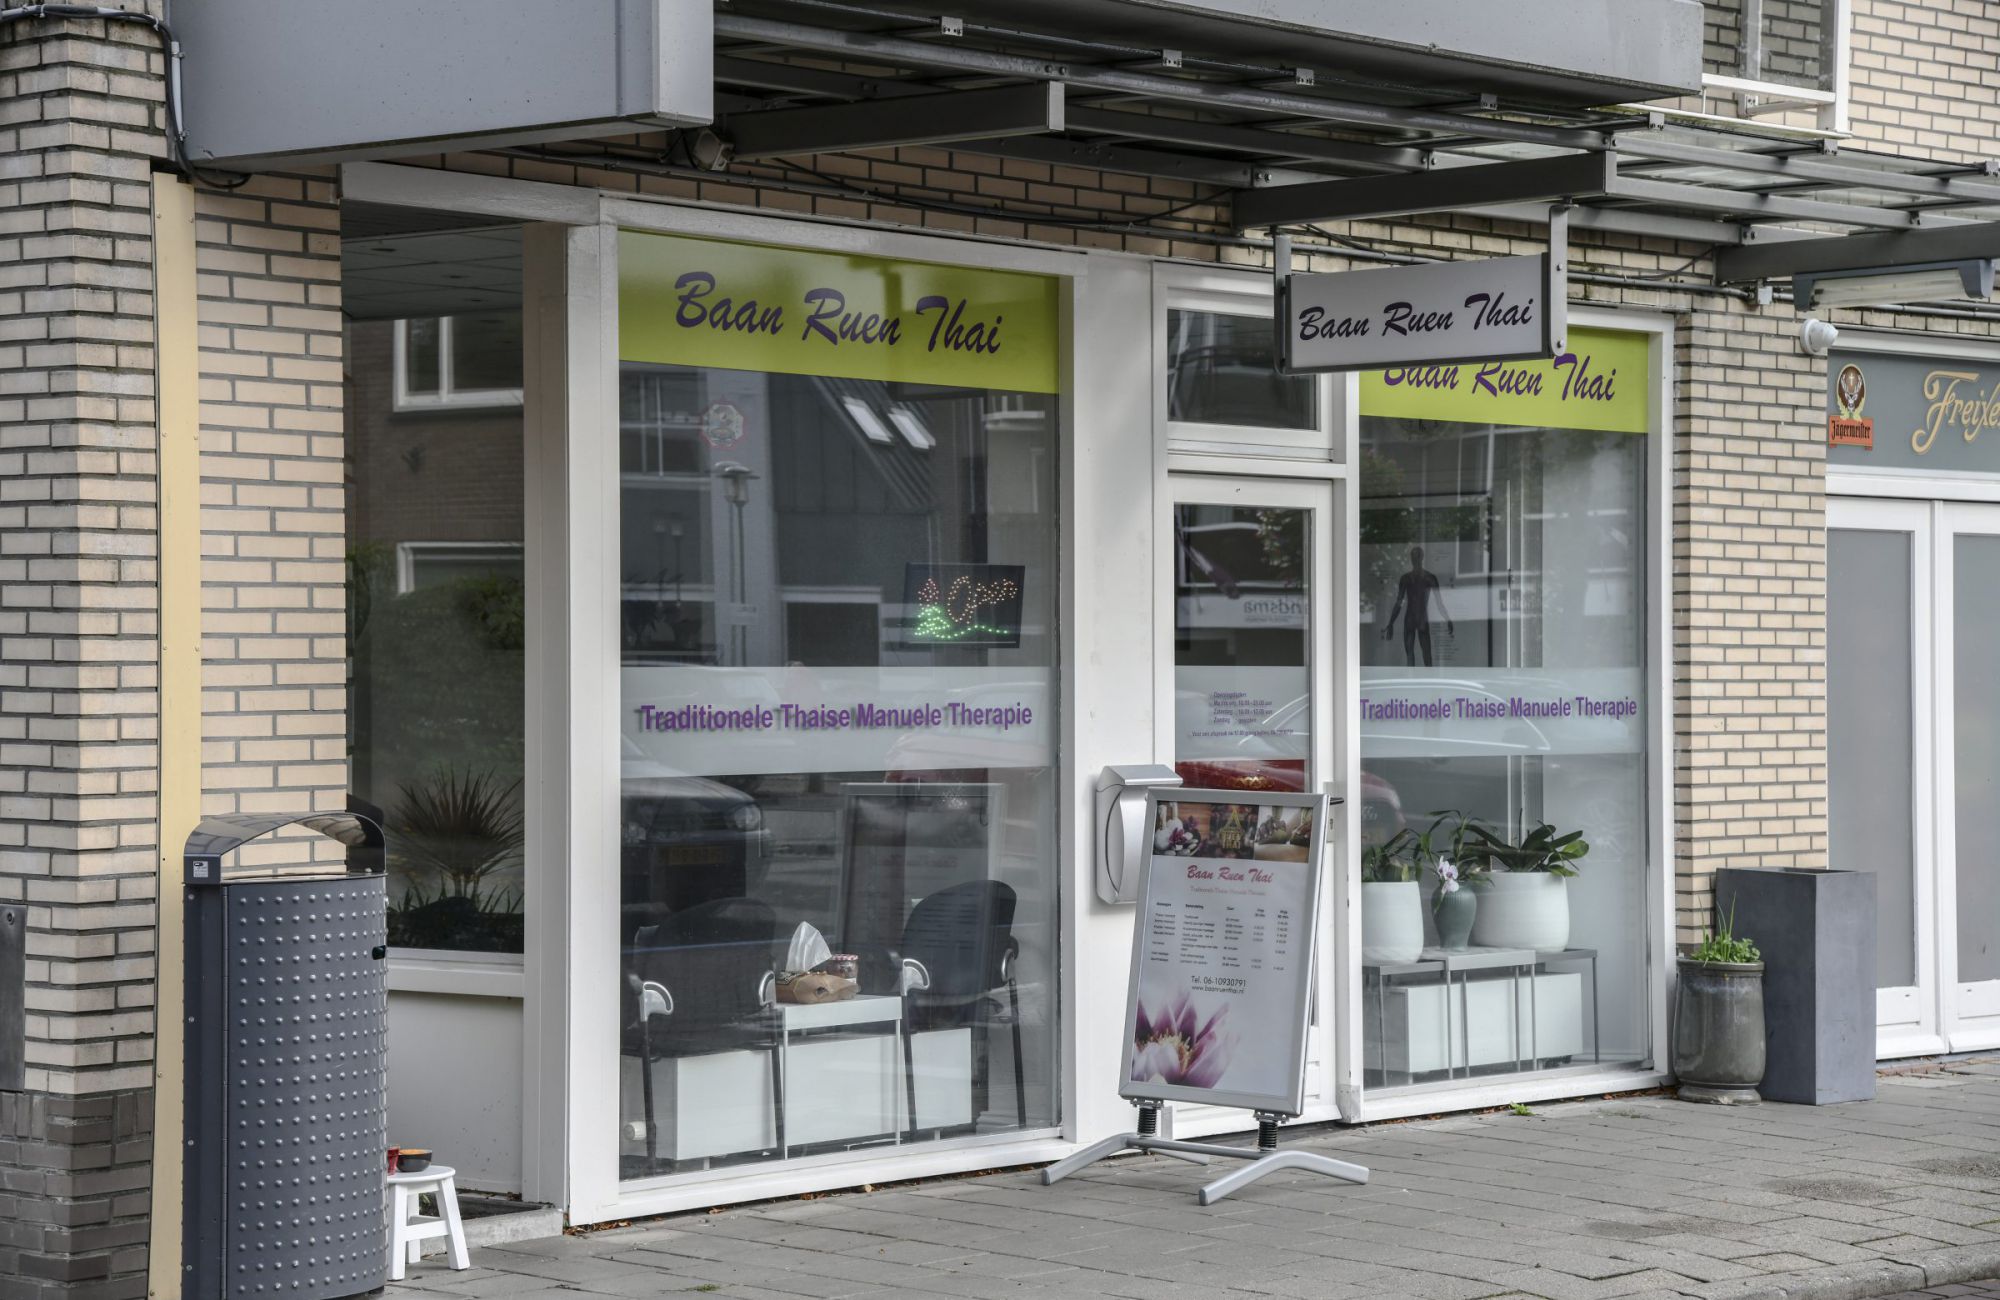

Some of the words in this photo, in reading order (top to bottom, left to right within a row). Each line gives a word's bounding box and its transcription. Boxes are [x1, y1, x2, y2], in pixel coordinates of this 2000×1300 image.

[674, 271, 783, 334] Baan
[801, 287, 901, 346] Ruen
[915, 295, 1002, 354] Thai
[1299, 306, 1370, 342] Baan
[1381, 301, 1454, 337] Ruen
[1464, 291, 1534, 330] Thai
[1552, 353, 1617, 401] Thai
[641, 703, 773, 729] Traditionele
[780, 703, 851, 728] Thaise
[858, 703, 942, 728] Manuele
[948, 701, 1033, 730] Therapie
[1360, 698, 1451, 719] Traditionele
[1456, 698, 1506, 718] Thaise
[1510, 697, 1571, 717] Manuele
[1575, 696, 1637, 719] Therapie
[1187, 865, 1214, 879] Baan
[1218, 867, 1244, 882] Ruen
[1248, 868, 1273, 884] Thai
